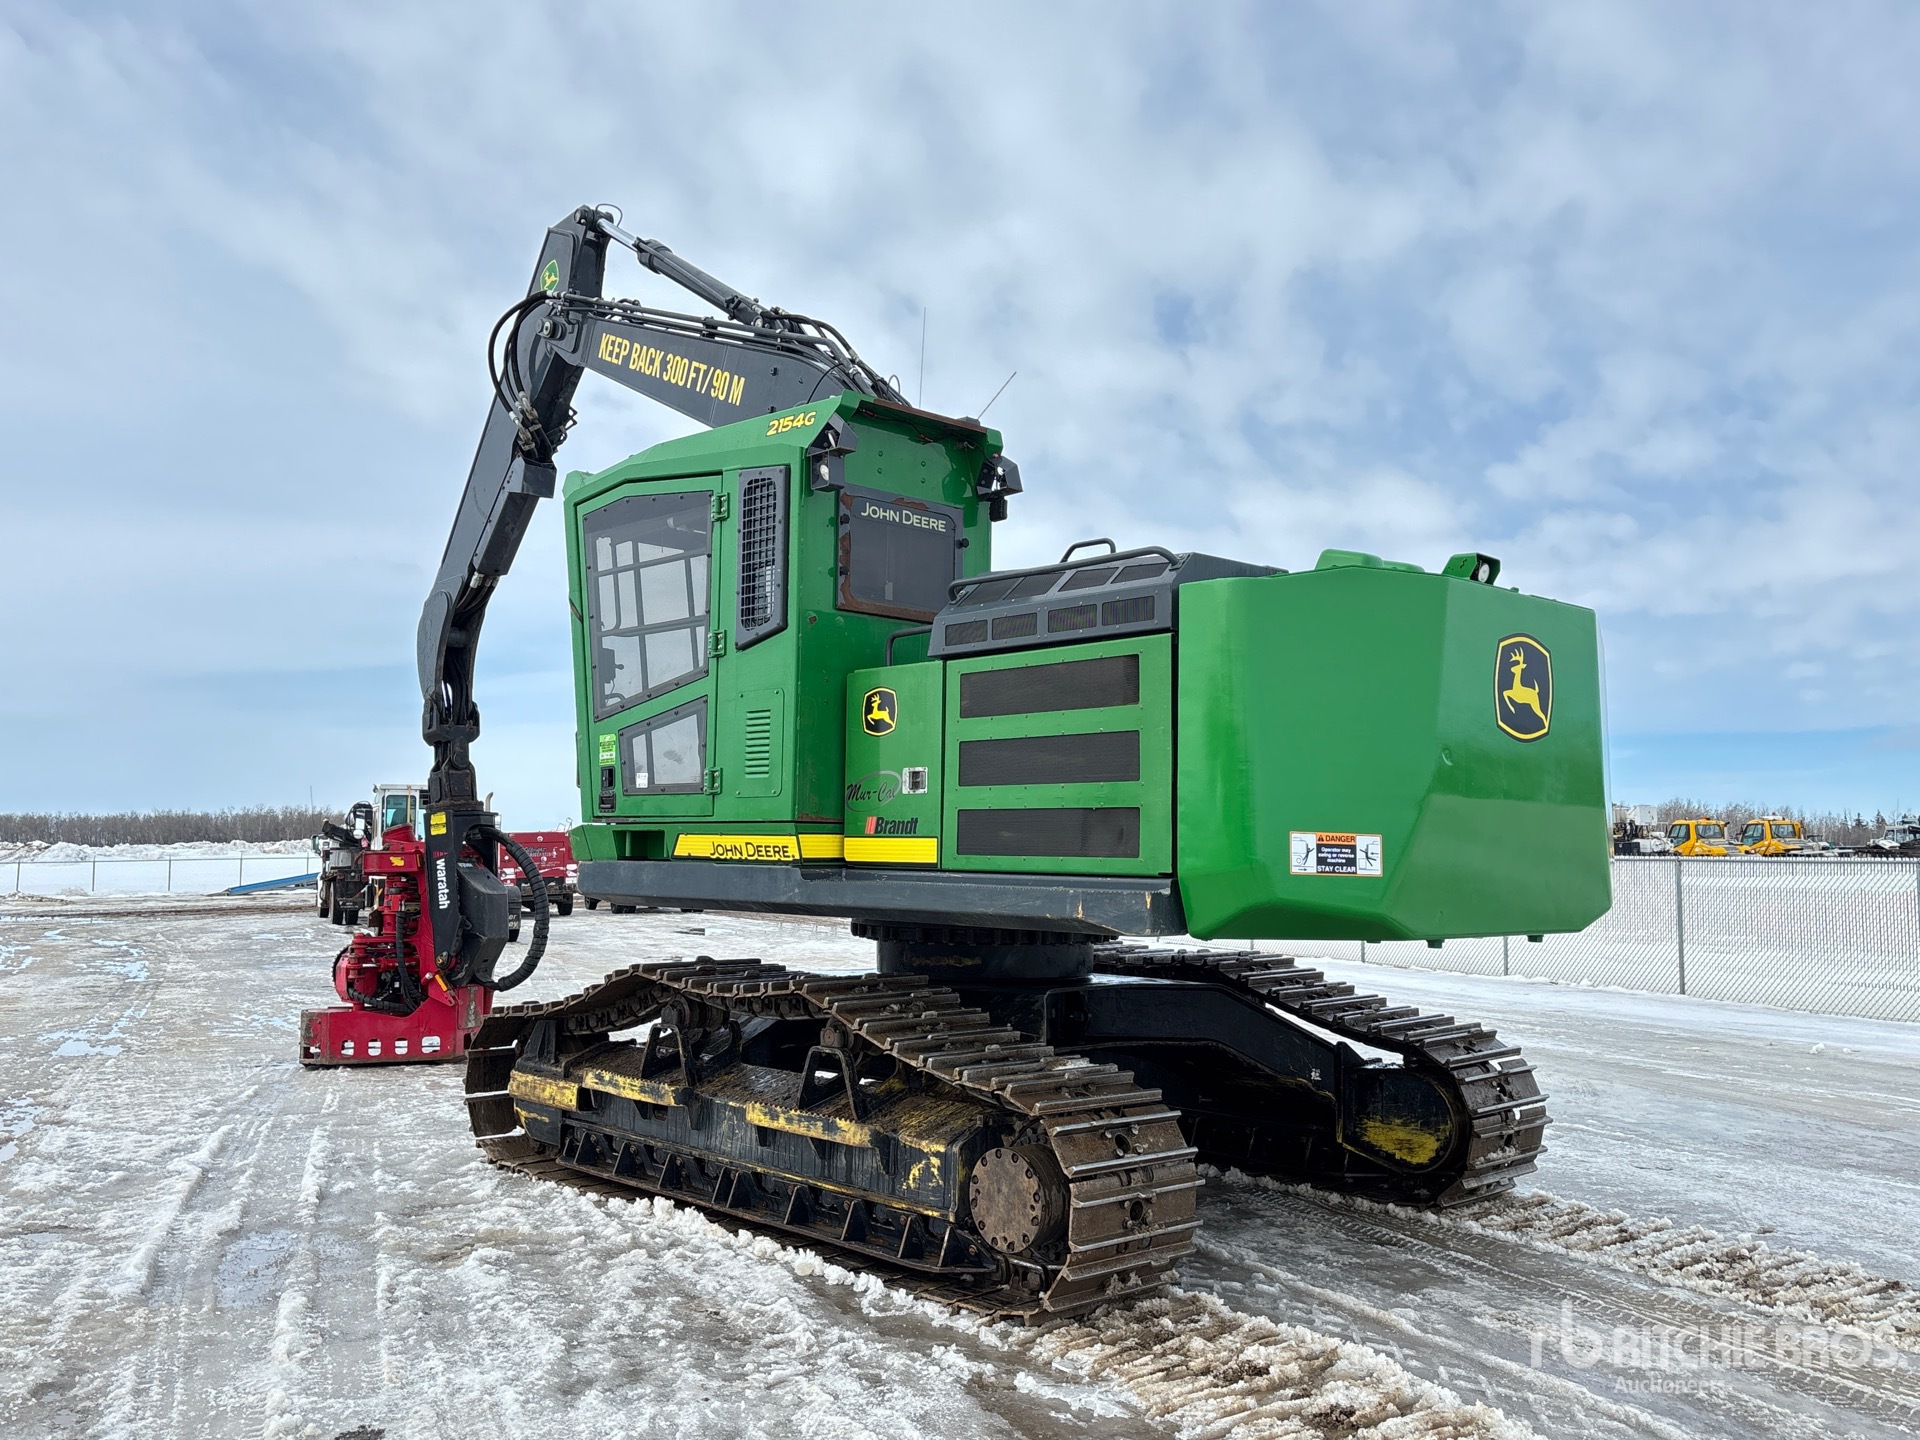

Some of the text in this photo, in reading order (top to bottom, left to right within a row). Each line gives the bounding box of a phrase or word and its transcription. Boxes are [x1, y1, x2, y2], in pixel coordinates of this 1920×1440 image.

[598, 332, 629, 366] KEEP
[629, 343, 664, 378] BACK
[663, 354, 689, 387] 300
[728, 376, 746, 406] M
[765, 411, 817, 437] 2154G
[861, 502, 946, 532] JOHN DEERE
[846, 781, 900, 802] Mur-Cal
[874, 816, 919, 835] Brandt
[709, 841, 744, 857] JOHN
[1325, 834, 1356, 843] DANGER
[1334, 865, 1356, 873] CLEAR
[436, 858, 451, 910] waratah
